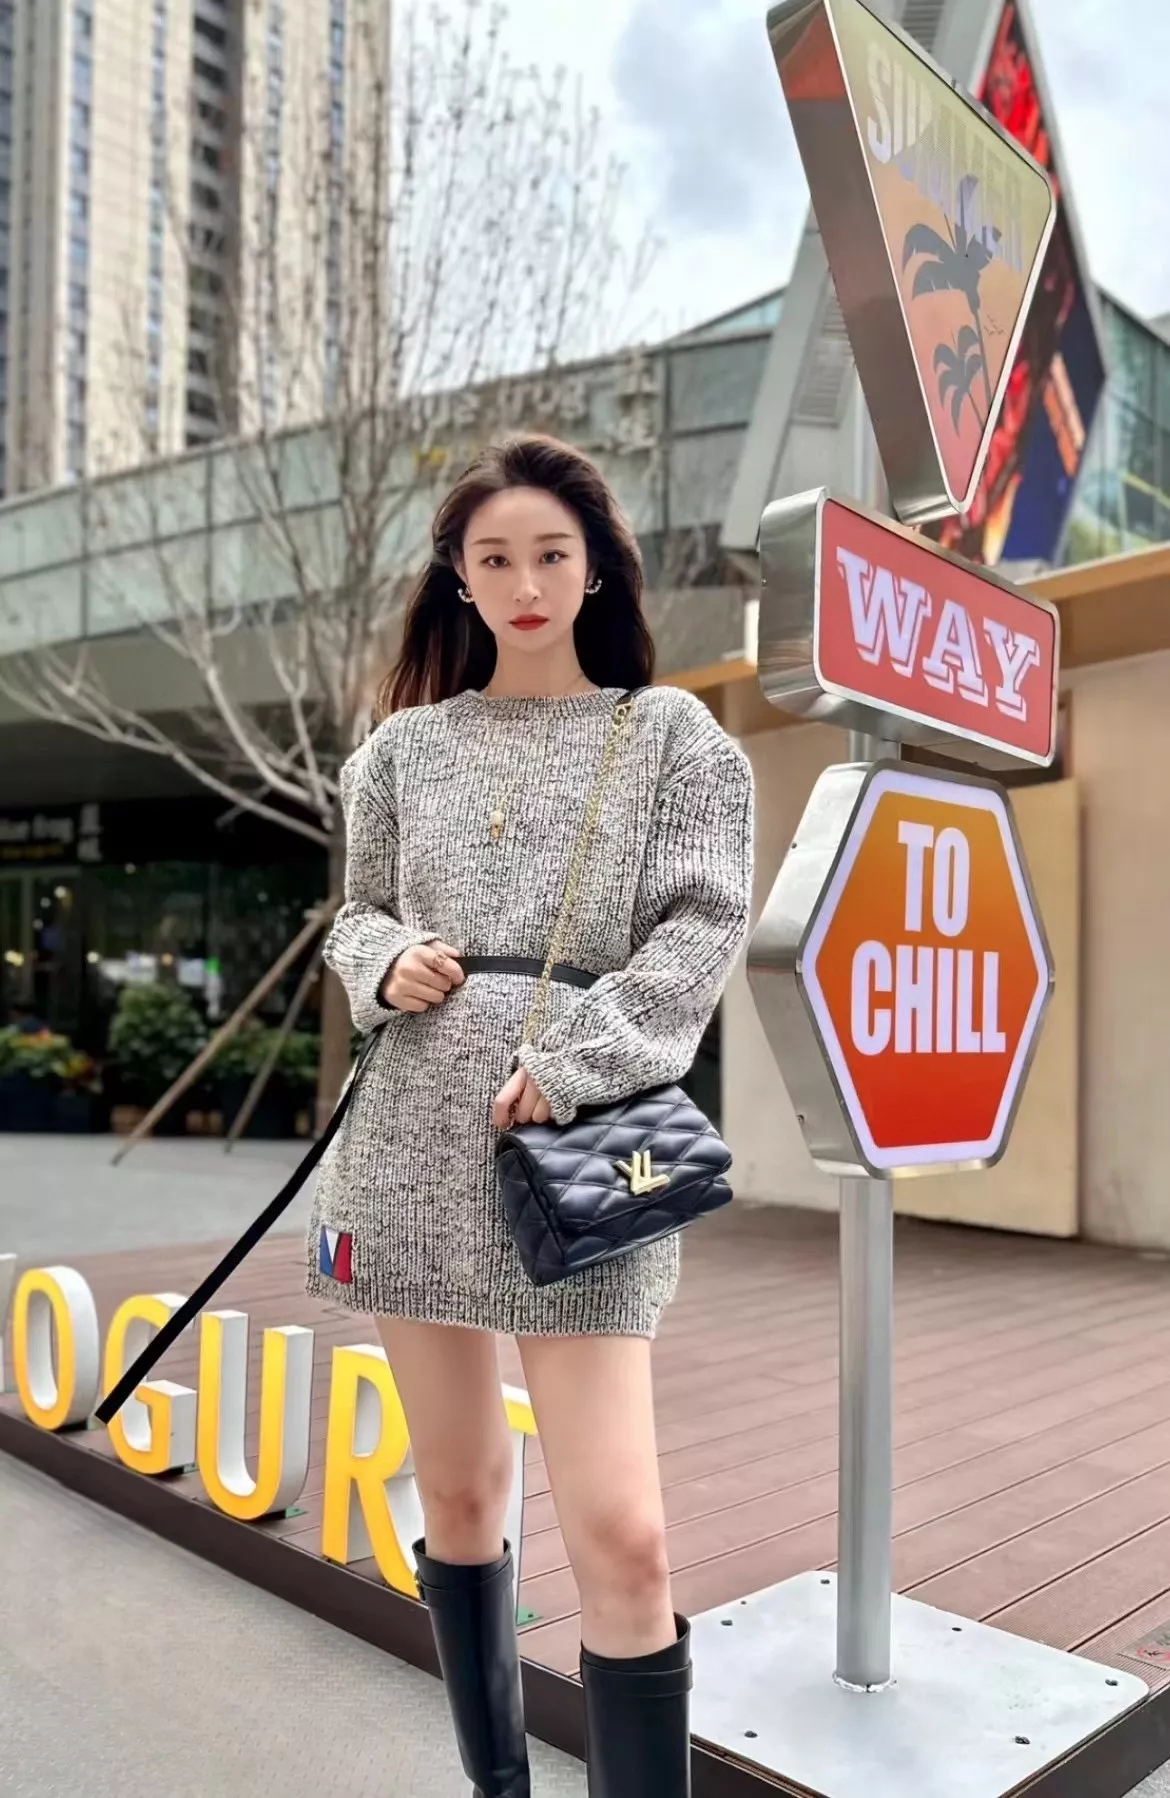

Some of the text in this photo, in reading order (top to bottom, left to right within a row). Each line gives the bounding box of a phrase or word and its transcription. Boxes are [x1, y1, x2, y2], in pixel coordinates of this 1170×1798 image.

[835, 546, 1041, 722] WAY
[898, 820, 970, 938] TO
[850, 940, 1006, 1057] CHILL
[0, 1256, 538, 1625] OGUR
